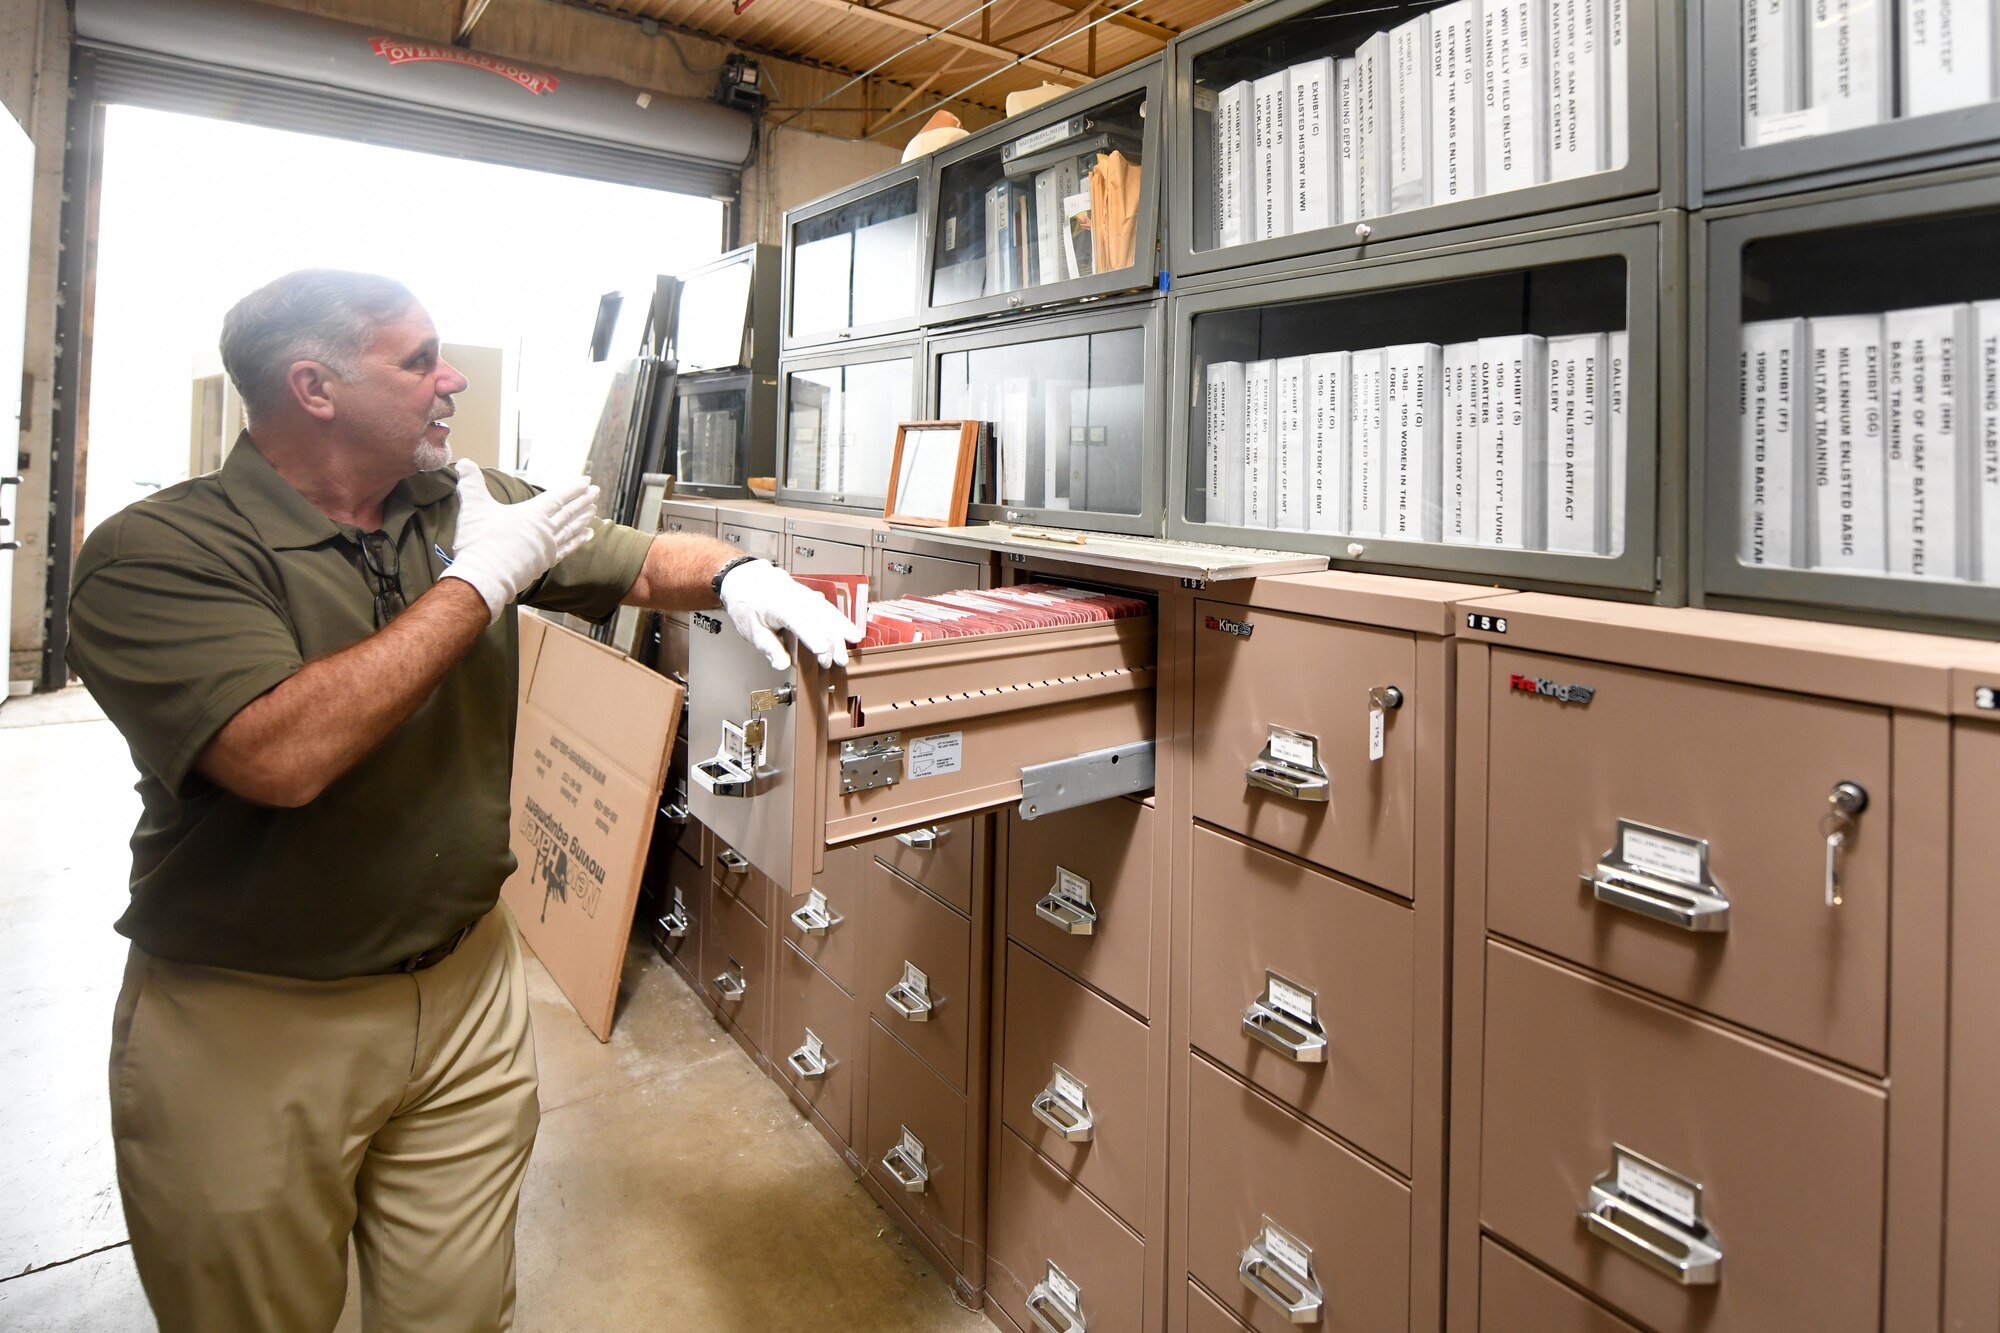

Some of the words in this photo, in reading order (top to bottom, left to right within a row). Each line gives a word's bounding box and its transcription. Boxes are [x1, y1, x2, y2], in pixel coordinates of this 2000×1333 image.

[1519, 3, 1528, 49] EXHIBIT
[391, 46, 491, 66] OVERHEAD
[494, 63, 539, 90] DOOR
[1519, 51, 1528, 69] (H)
[1568, 51, 1576, 67] OF
[1219, 108, 1223, 119] OF
[1266, 137, 1271, 150] OF
[1299, 179, 1306, 189] IN
[1585, 358, 1594, 406] EXHIBIT
[1779, 349, 1788, 404] EXHIBIT
[1816, 349, 1826, 415] MILITARY
[1866, 346, 1878, 402] EXHIBIT
[1890, 341, 1901, 384] BASIC
[1913, 339, 1924, 407] HISTORY
[1940, 337, 1952, 398] EXHIBIT
[1985, 337, 1997, 411] TRAINING
[1840, 347, 1850, 436] MILLENNIUM
[1246, 432, 1250, 444] TO
[1253, 432, 1258, 443] TO
[1584, 409, 1593, 426] (T)
[1755, 397, 1765, 463] ENLISTED
[1778, 407, 1788, 433] (FF)
[1890, 389, 1901, 461] TRAINING
[1913, 411, 1924, 428] OF
[1816, 418, 1827, 487] TRAINING
[1913, 434, 1924, 472] USAF
[1985, 417, 1998, 485] HABITAT
[1282, 479, 1287, 492] OF
[1317, 479, 1322, 492] OF
[1400, 474, 1407, 486] IN
[1456, 483, 1462, 498] OF
[1755, 467, 1765, 506] BASIC
[1841, 440, 1852, 510] ENLISTED
[1913, 477, 1924, 534] BATTLE
[1842, 514, 1852, 556] BASIC
[1183, 579, 1206, 590] 192
[1467, 614, 1506, 632] 156
[525, 796, 569, 848] equipment
[570, 837, 606, 885] moving
